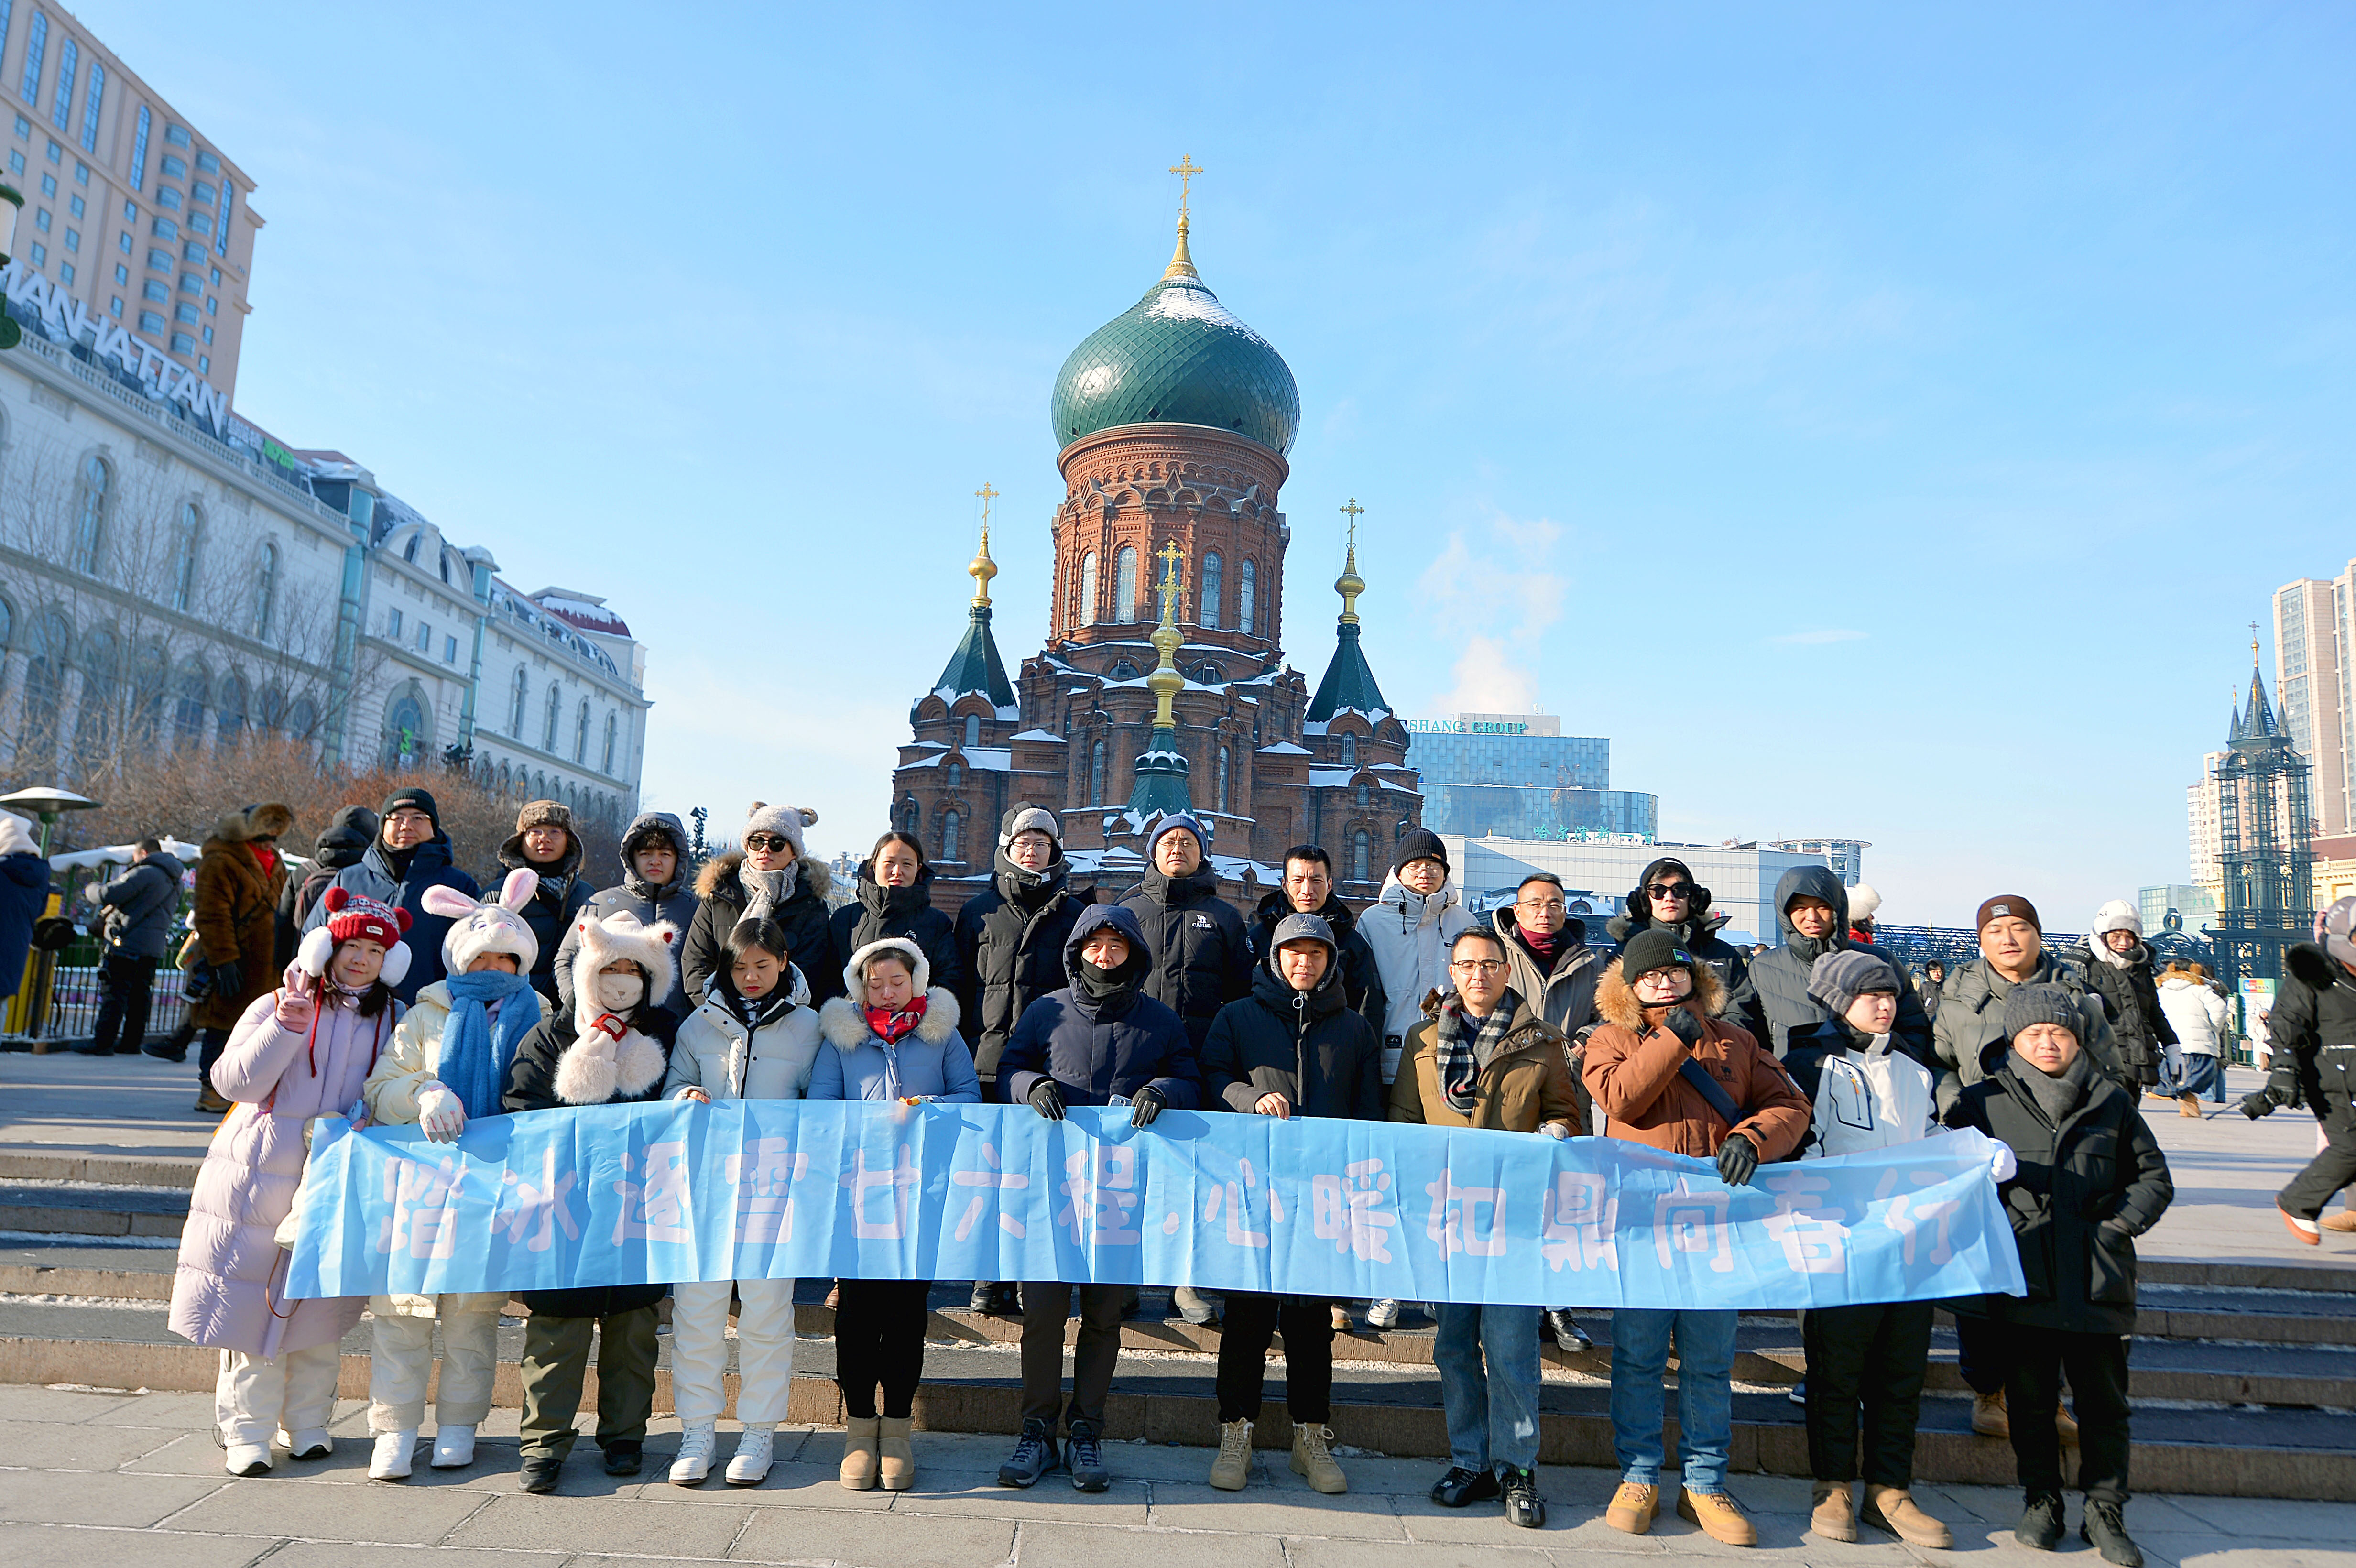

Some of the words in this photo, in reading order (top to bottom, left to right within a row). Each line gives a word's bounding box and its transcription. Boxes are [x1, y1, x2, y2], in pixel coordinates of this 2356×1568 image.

[1471, 721, 1526, 734] GROUP
[1533, 823, 1655, 845] 哈尔滨新一百
